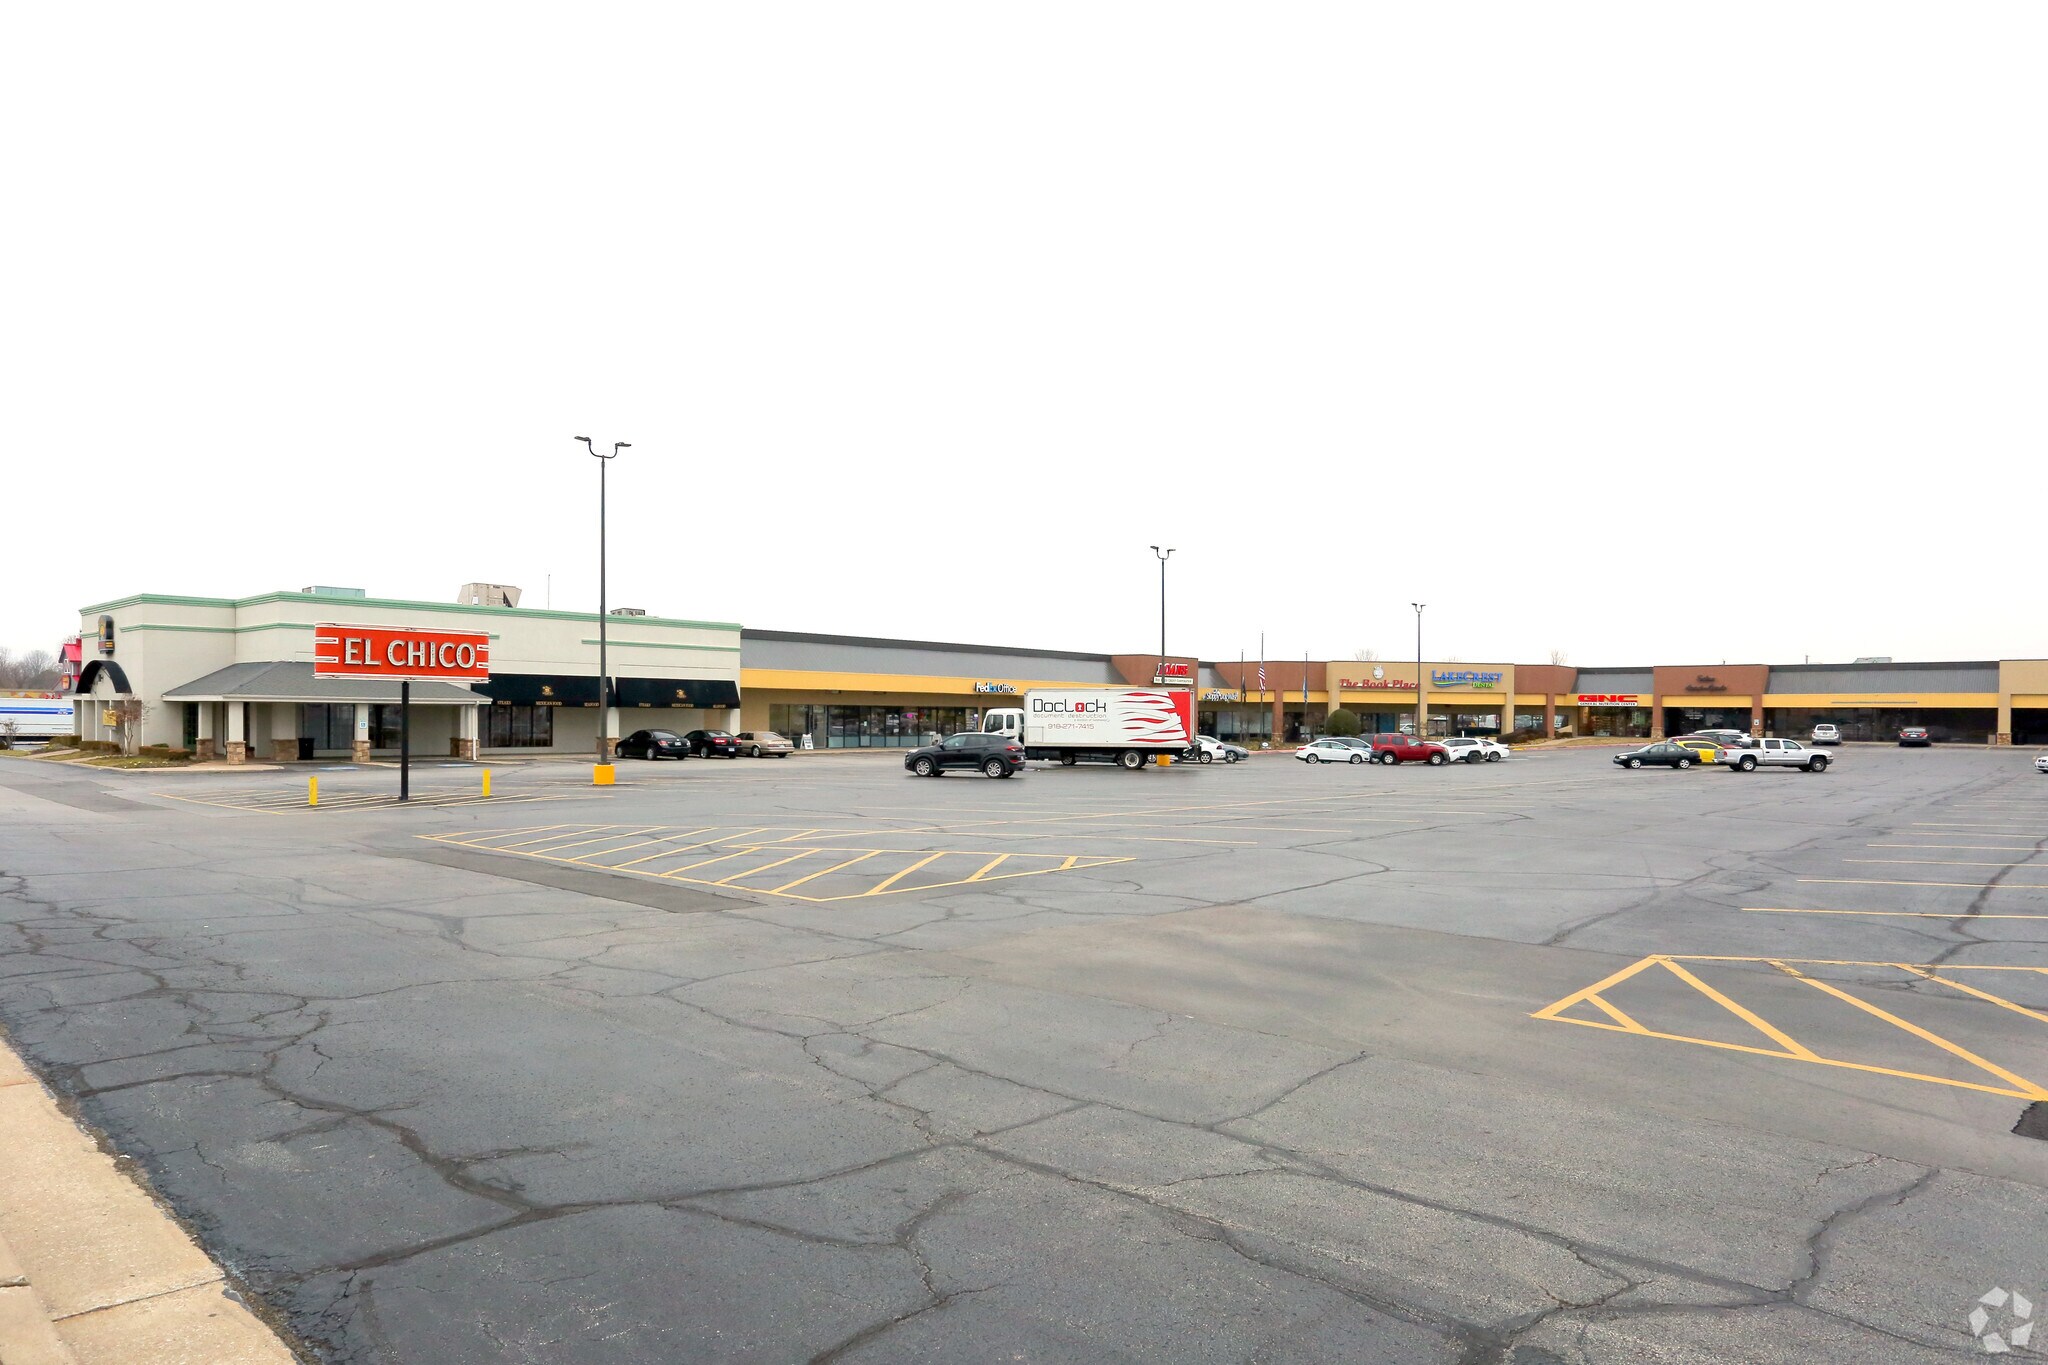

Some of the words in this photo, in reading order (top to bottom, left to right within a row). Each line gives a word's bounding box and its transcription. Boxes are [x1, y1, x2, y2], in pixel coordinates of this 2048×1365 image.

[344, 637, 381, 665] EL
[387, 639, 476, 669] CHICO
[975, 681, 997, 693] FedEx
[997, 683, 1017, 693] Office
[1339, 679, 1358, 687] The
[1362, 679, 1388, 688] Book
[1578, 694, 1638, 702] GNC
[1033, 698, 1107, 712] DocLock
